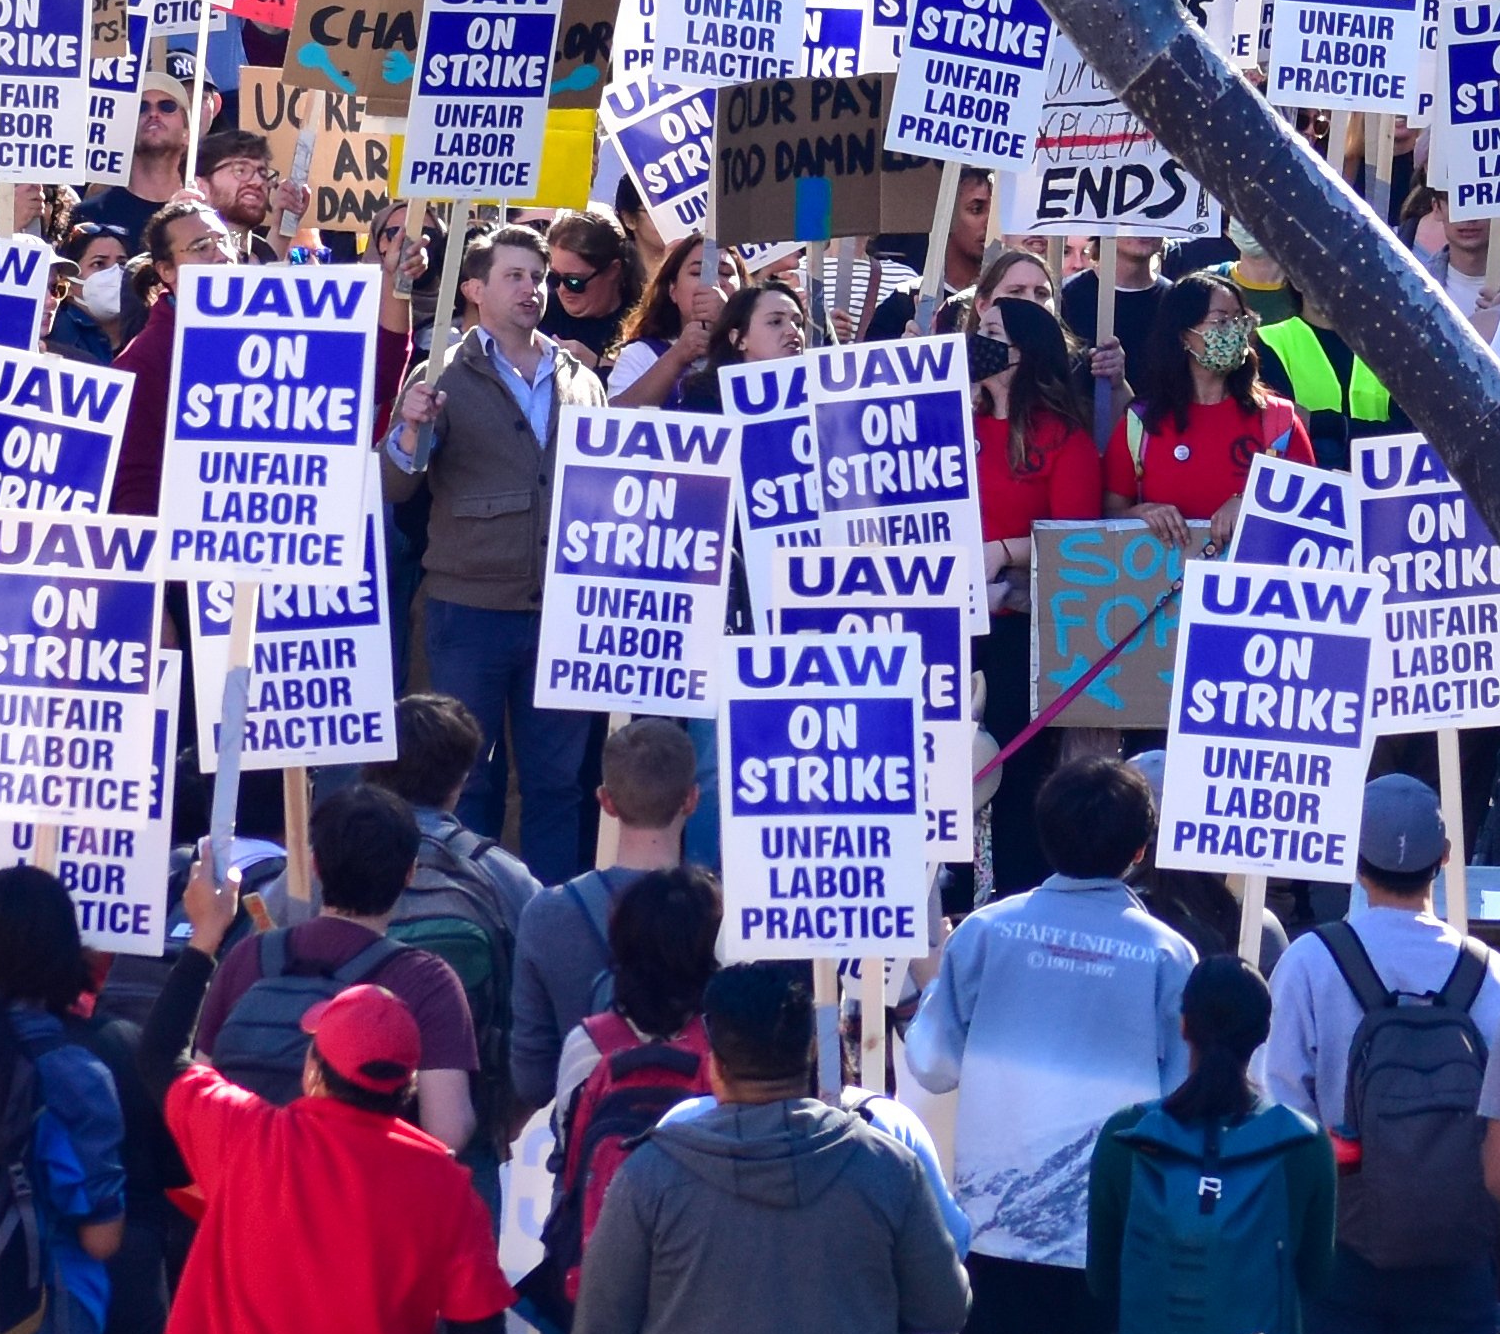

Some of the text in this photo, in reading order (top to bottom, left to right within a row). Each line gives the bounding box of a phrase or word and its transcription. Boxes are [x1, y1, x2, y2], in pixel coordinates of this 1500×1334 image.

[1298, 9, 1394, 40] UNFAIR
[1300, 38, 1386, 69] LABOR
[1277, 65, 1406, 99] PRACTICE
[727, 79, 881, 136] OUR PAY
[719, 147, 776, 196] TOO
[779, 133, 875, 179] DAMN
